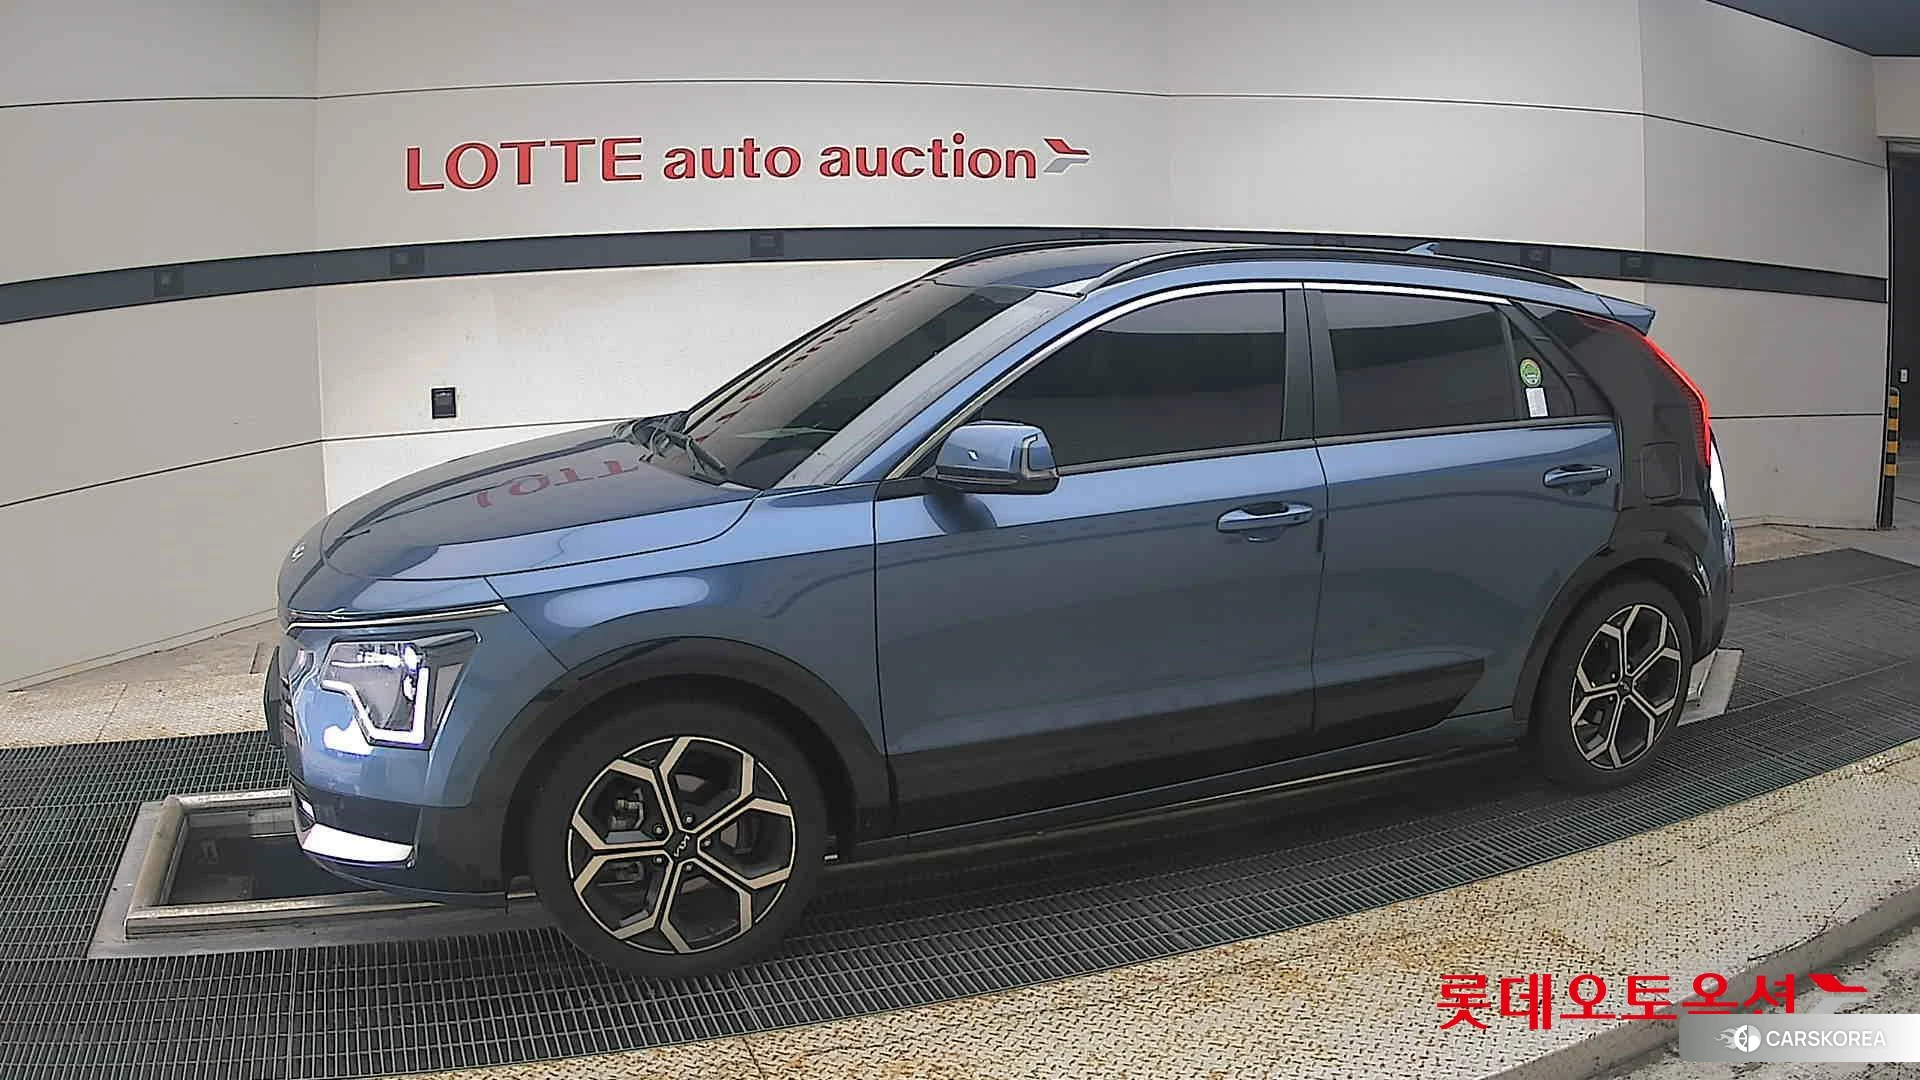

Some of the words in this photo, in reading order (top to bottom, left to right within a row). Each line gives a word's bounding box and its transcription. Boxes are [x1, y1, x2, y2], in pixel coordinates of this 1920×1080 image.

[405, 136, 642, 192] LOTTE
[662, 137, 801, 181] auto
[818, 132, 1038, 180] auction
